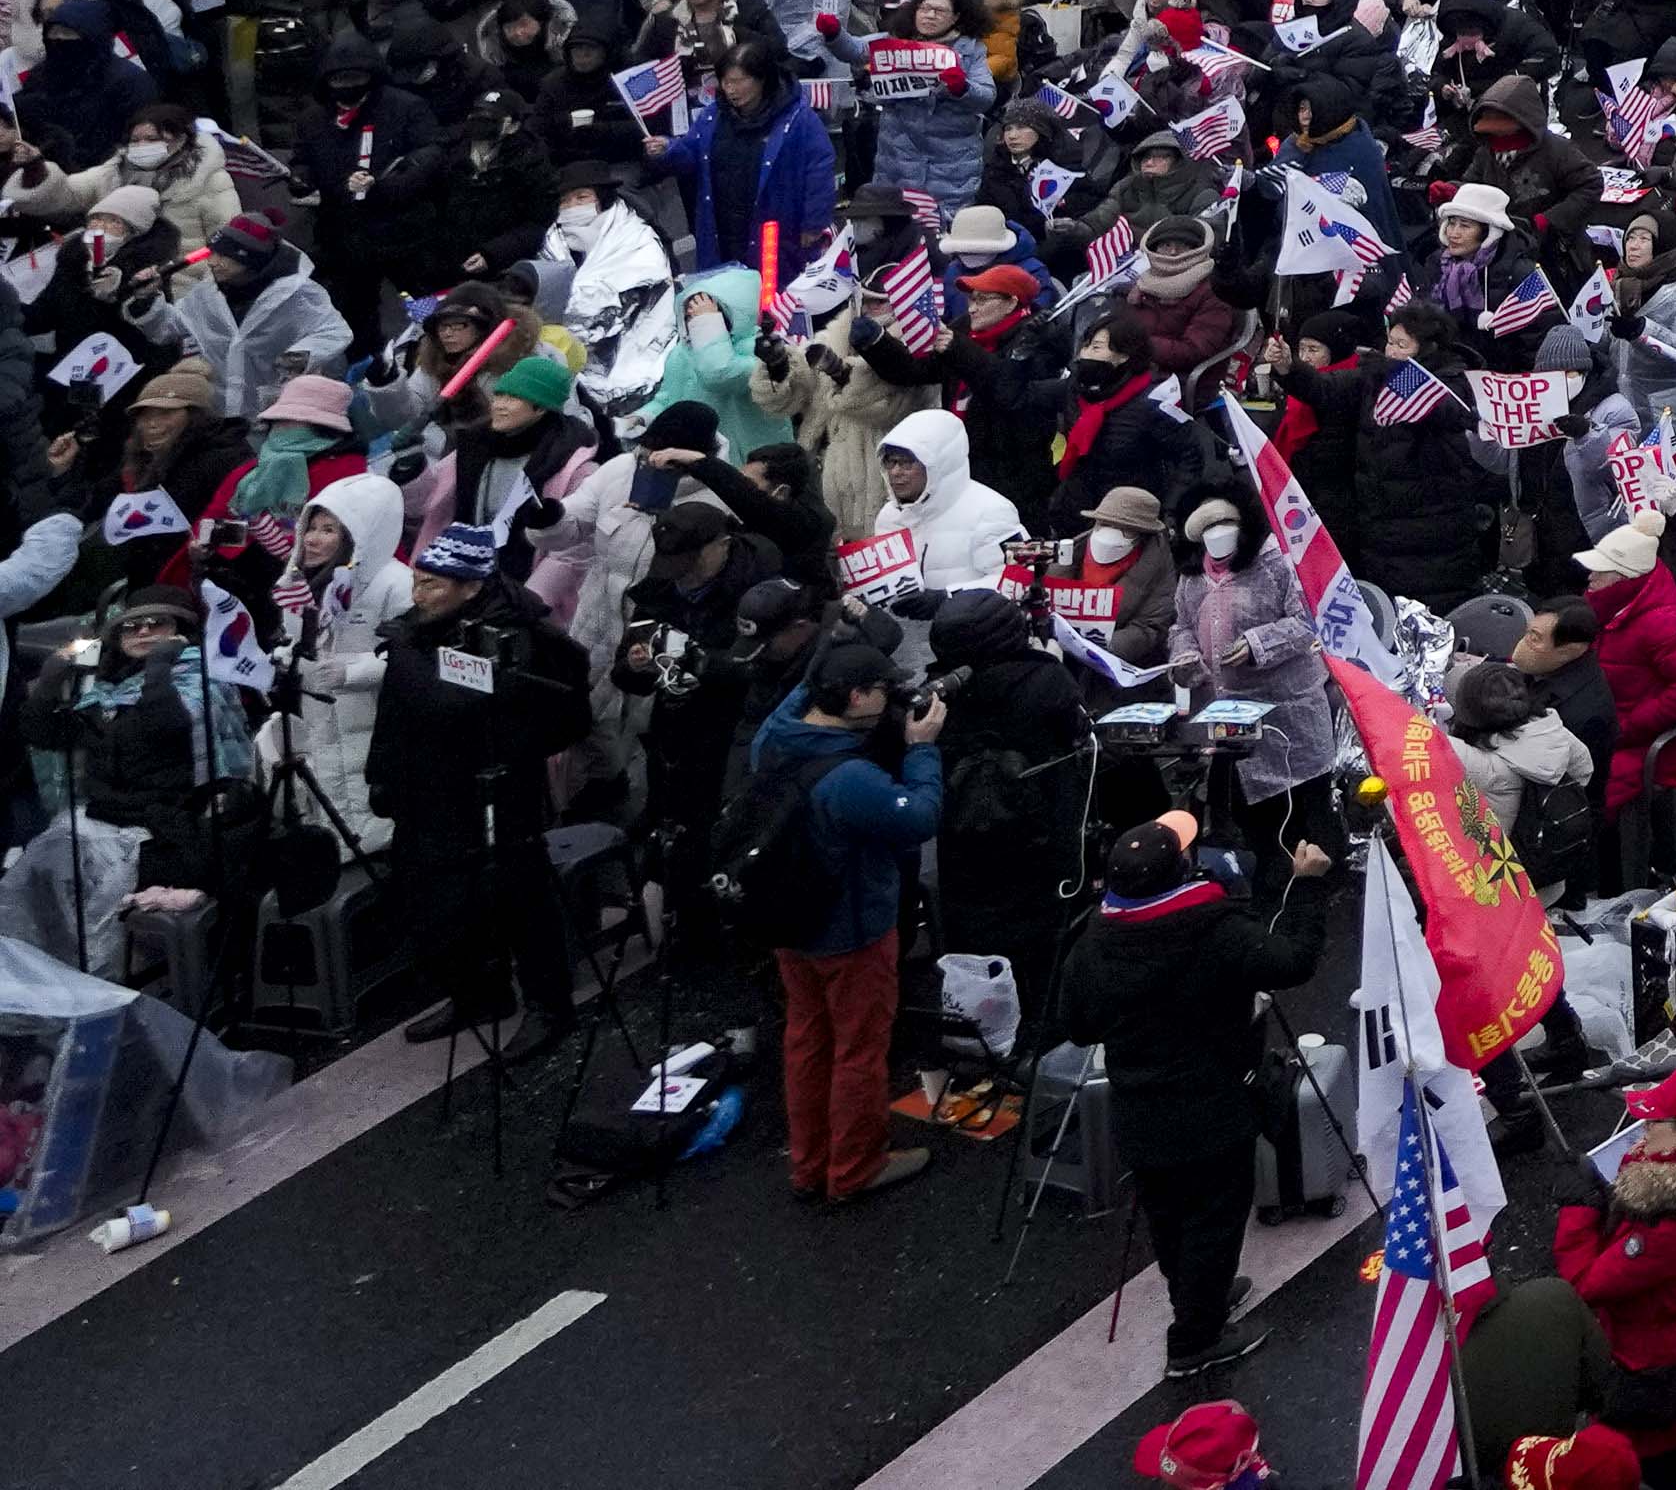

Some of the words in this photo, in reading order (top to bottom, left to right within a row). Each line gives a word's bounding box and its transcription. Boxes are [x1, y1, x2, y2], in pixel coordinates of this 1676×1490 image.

[873, 48, 957, 71] 탄핵반대
[873, 77, 928, 98] 이재명
[1481, 376, 1549, 402] STOP
[1489, 400, 1542, 424] THE
[1611, 455, 1644, 481] OP
